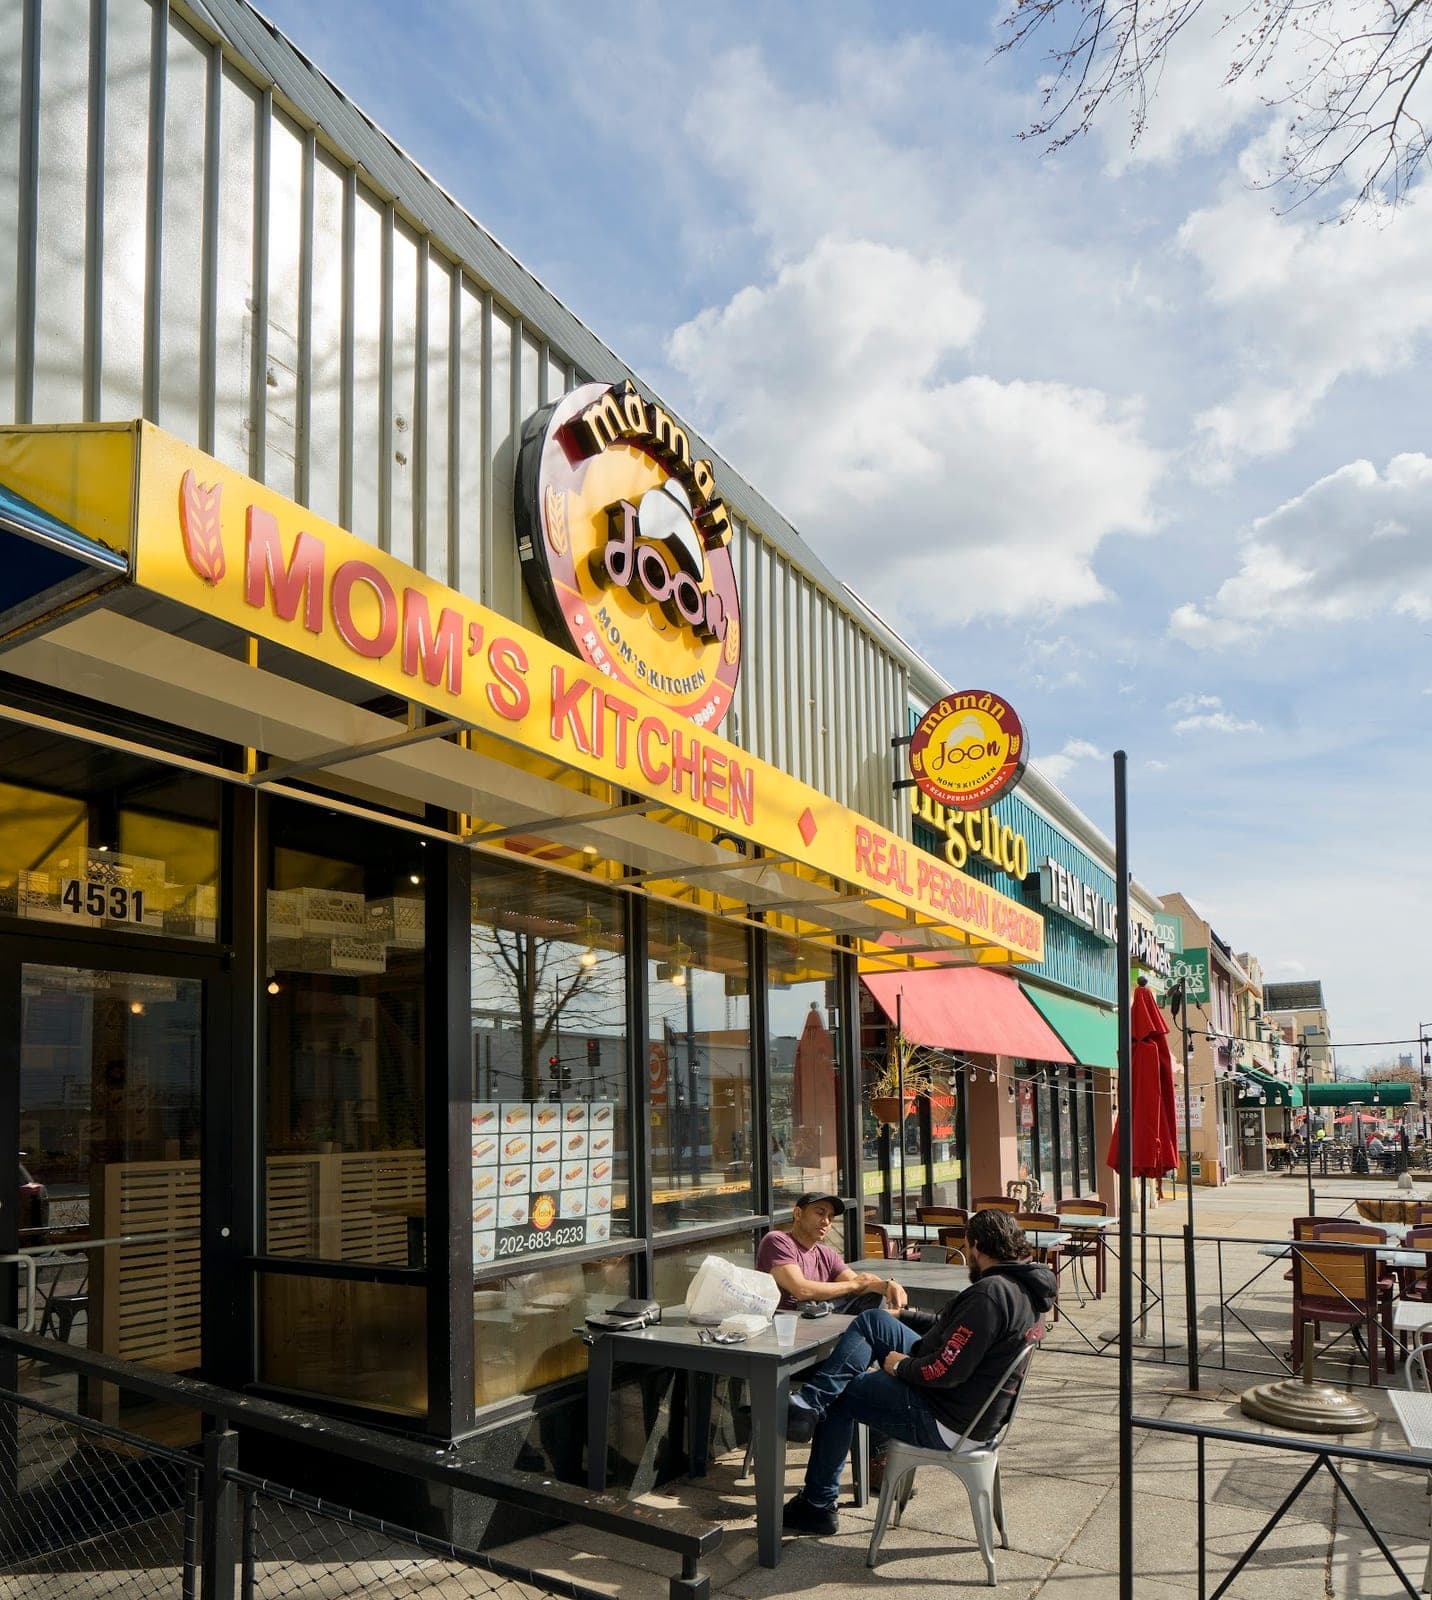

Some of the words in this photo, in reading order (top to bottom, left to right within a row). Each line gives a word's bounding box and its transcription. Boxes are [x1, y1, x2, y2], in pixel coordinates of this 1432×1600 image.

[583, 631, 619, 680] REA
[648, 668, 706, 695] KITCHEN
[551, 665, 754, 826] KITCHEN
[946, 792, 979, 801] PERSIAN
[963, 766, 997, 788] KITCHEN
[855, 824, 914, 897] REAL
[917, 857, 989, 929] PERSIAN
[1048, 857, 1100, 931] TENLEY
[63, 879, 143, 923] 4531
[499, 1226, 584, 1255] 202-683-6233
